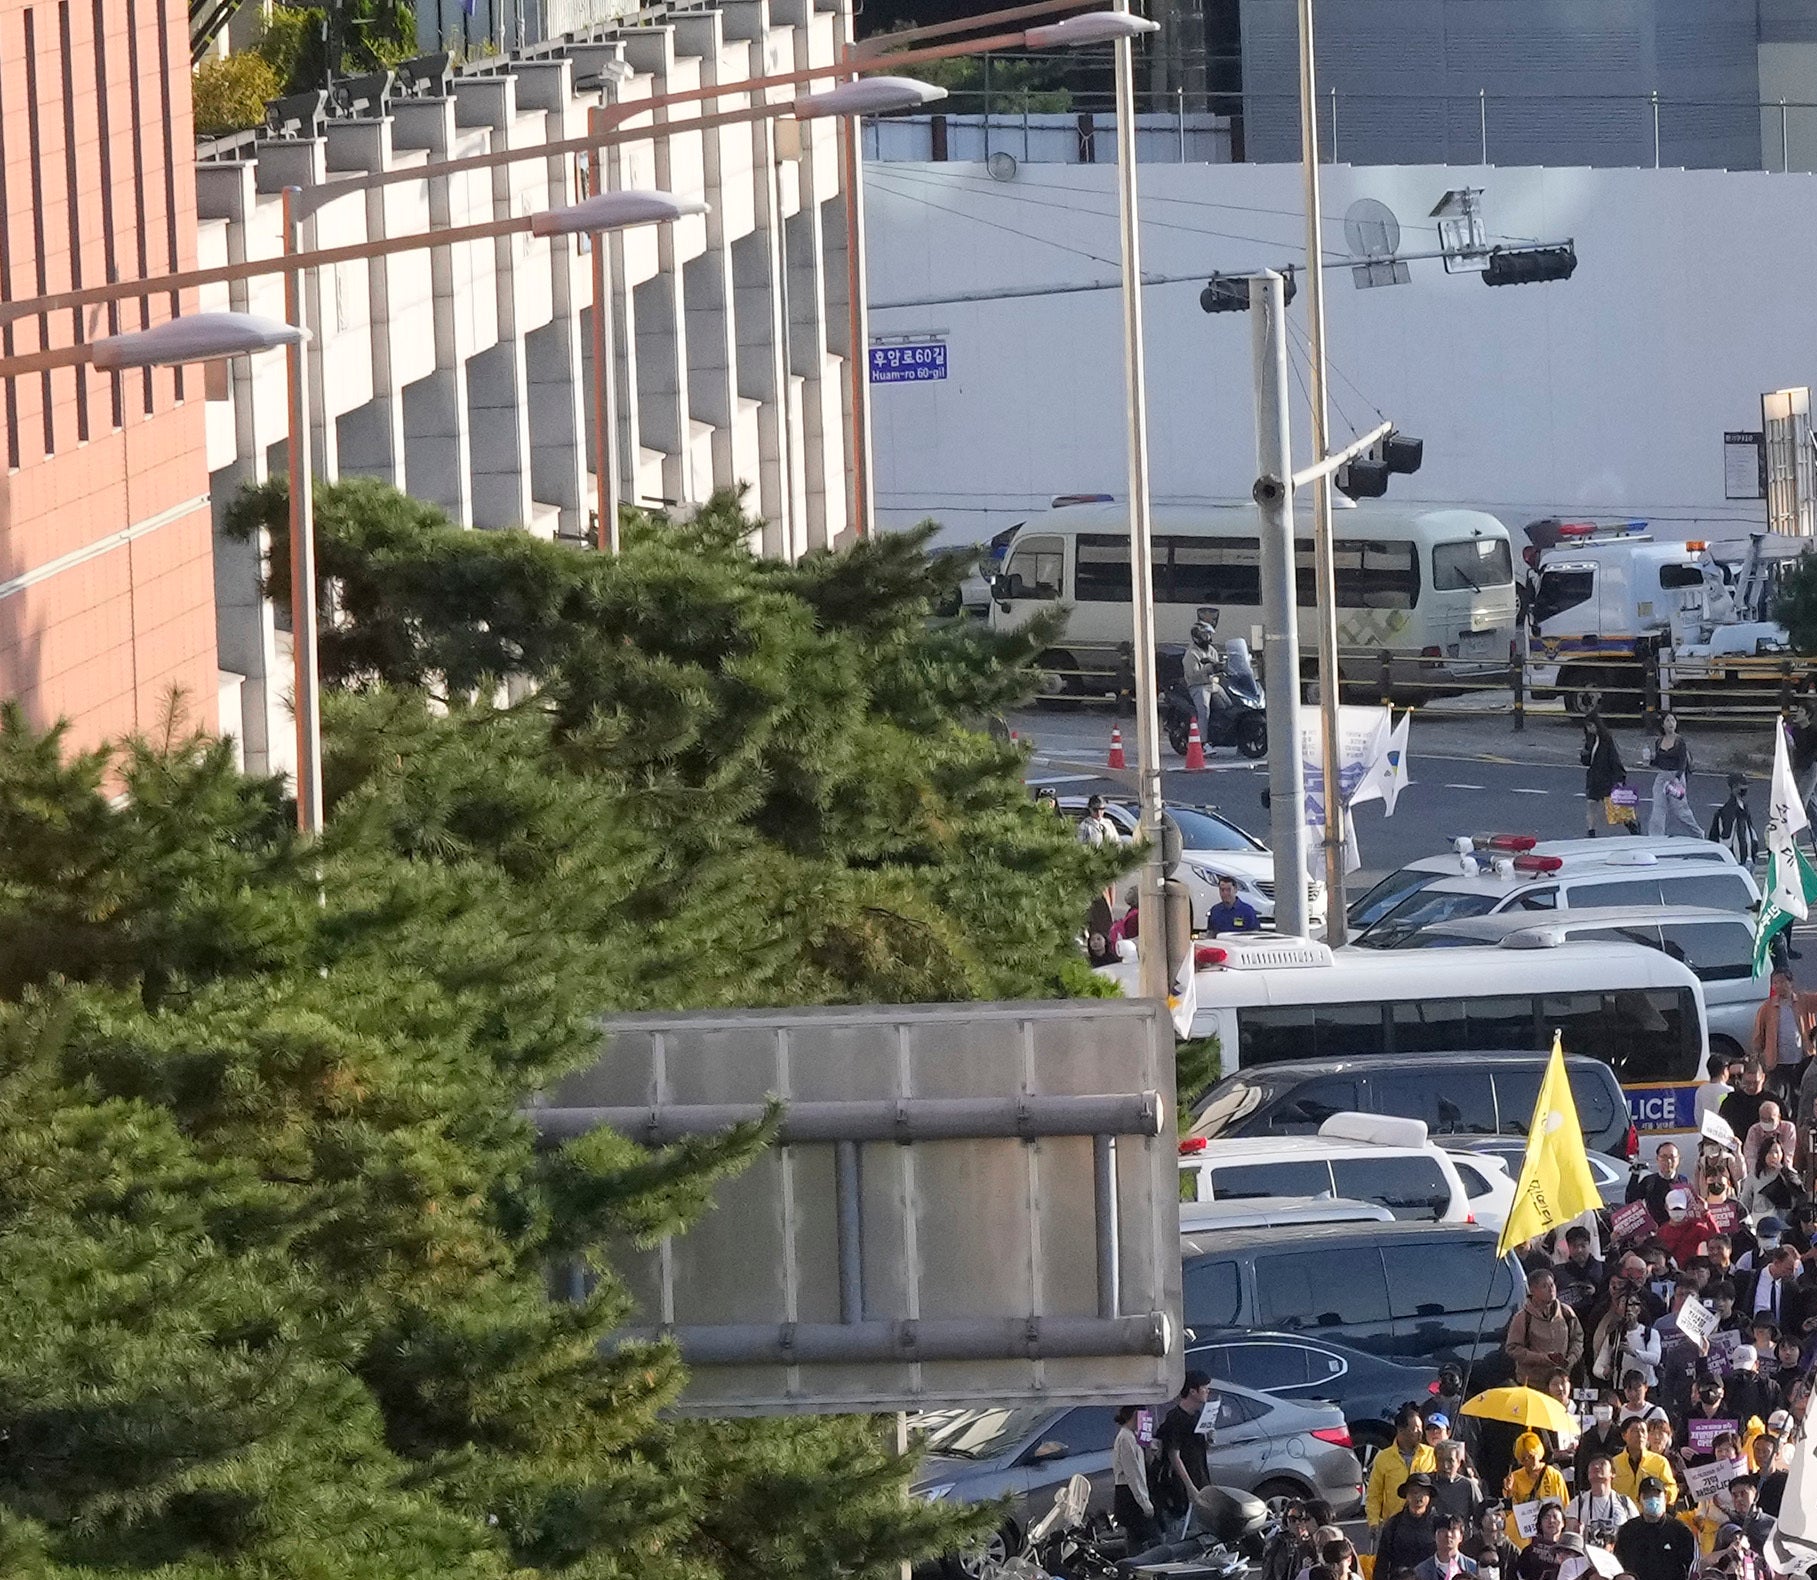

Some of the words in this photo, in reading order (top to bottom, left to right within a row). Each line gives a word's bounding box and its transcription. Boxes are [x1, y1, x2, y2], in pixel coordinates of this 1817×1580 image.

[873, 348, 946, 367] 후암로60길
[872, 368, 915, 382] Huam-ro
[917, 366, 946, 380] 60-gil
[1629, 1098, 1675, 1120] LICE
